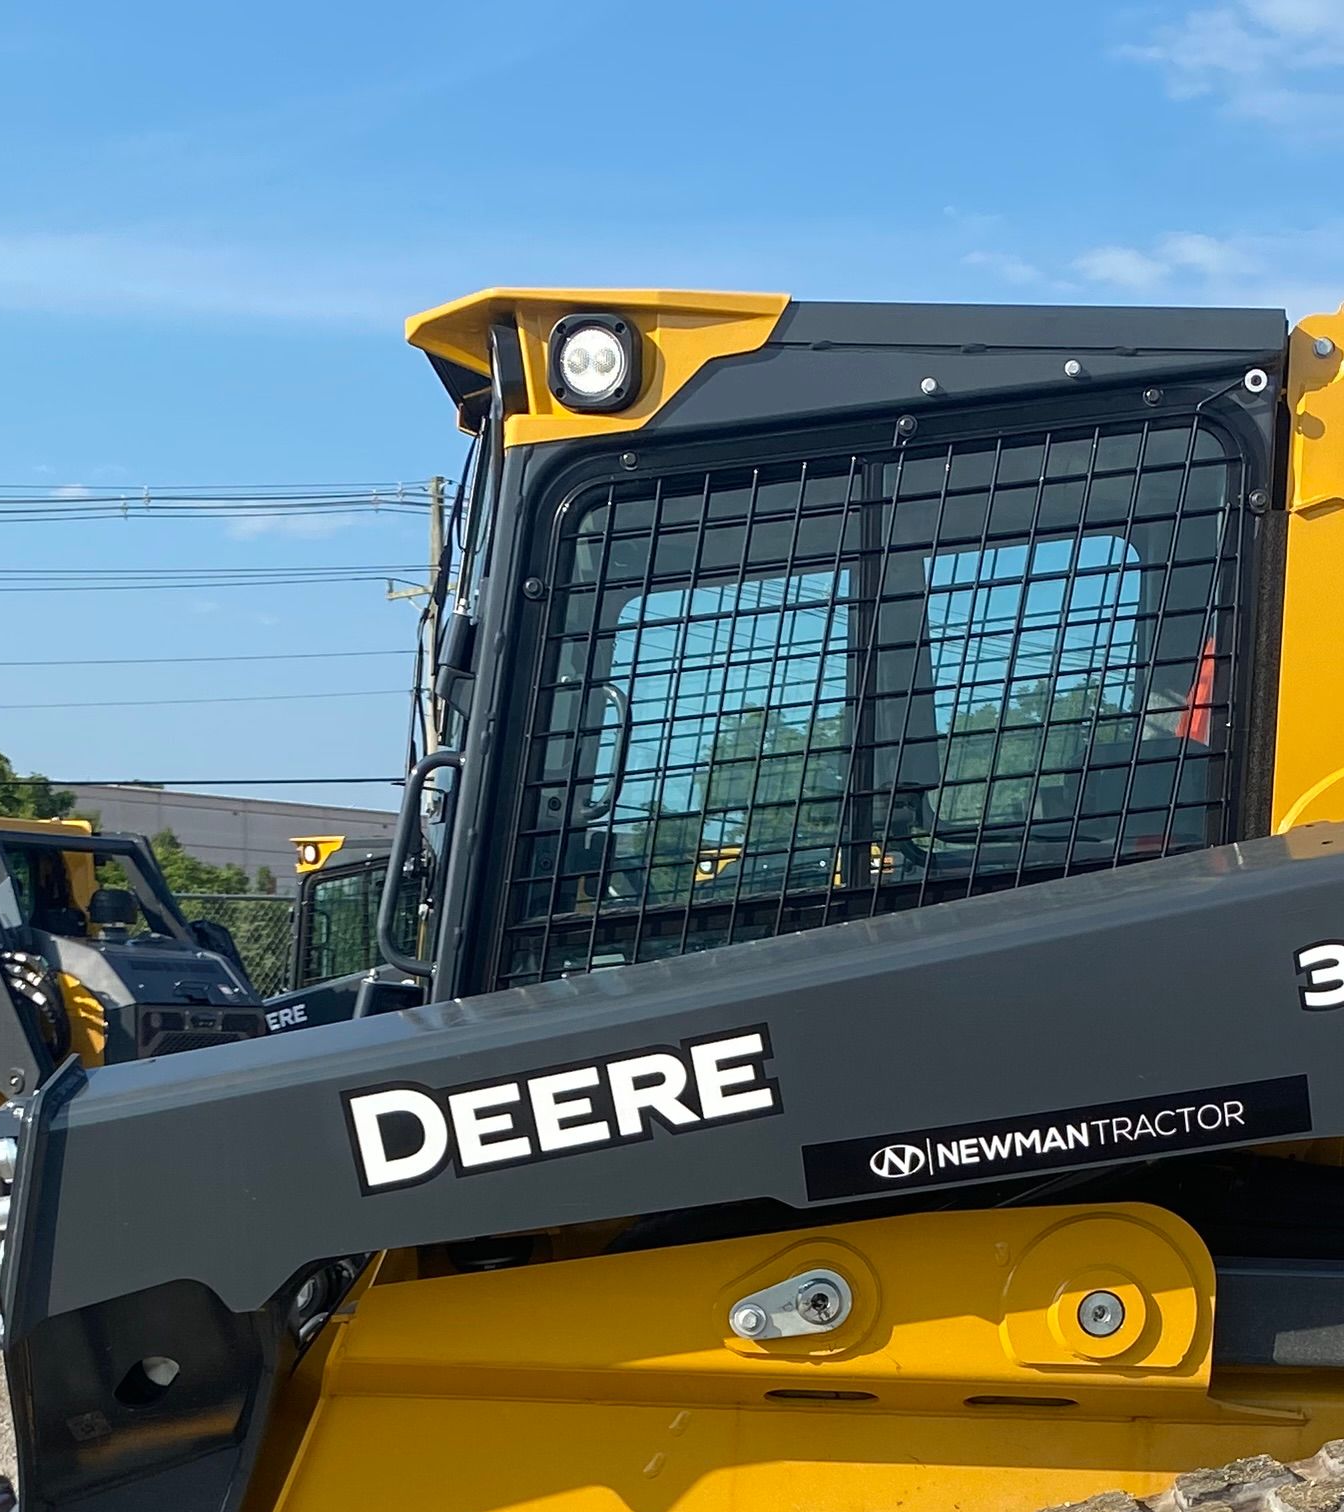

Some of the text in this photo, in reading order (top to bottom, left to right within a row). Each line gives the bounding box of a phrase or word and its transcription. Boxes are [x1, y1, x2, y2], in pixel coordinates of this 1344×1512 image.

[265, 1003, 308, 1031] ERE
[349, 1033, 774, 1187] DEERE
[937, 1100, 1246, 1169] NEWMANTRACTOR
